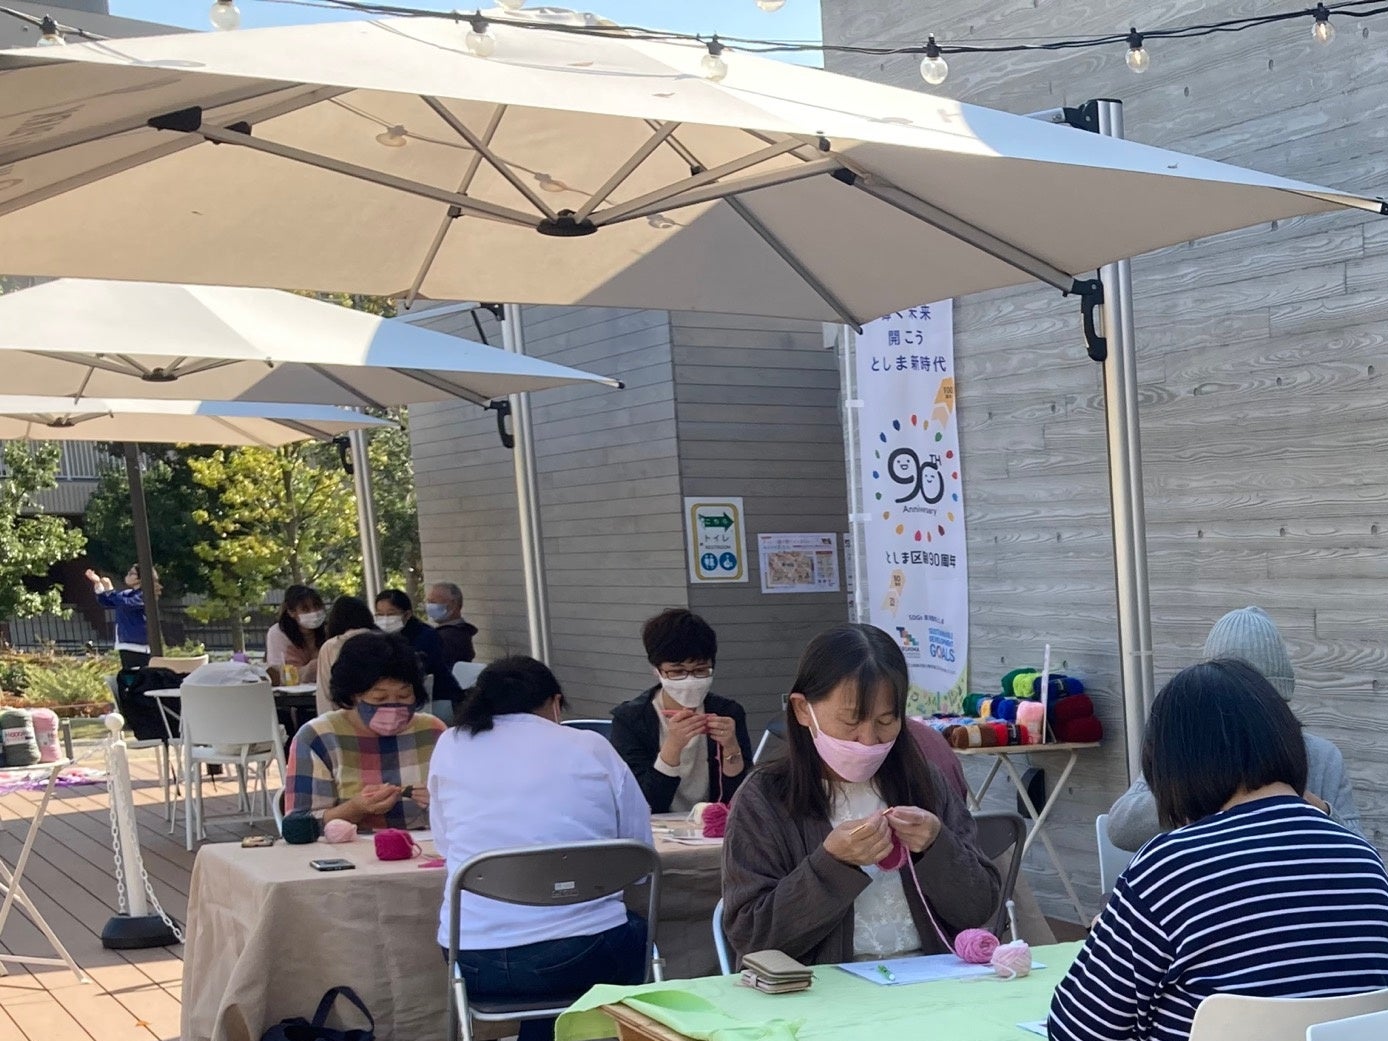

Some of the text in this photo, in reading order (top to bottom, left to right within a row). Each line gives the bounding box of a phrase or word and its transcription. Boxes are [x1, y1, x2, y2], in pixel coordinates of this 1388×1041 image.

[888, 330, 924, 346] 開こう
[871, 356, 947, 373] としま新時代
[704, 534, 729, 542] トイレ
[930, 643, 956, 663] GOALS
